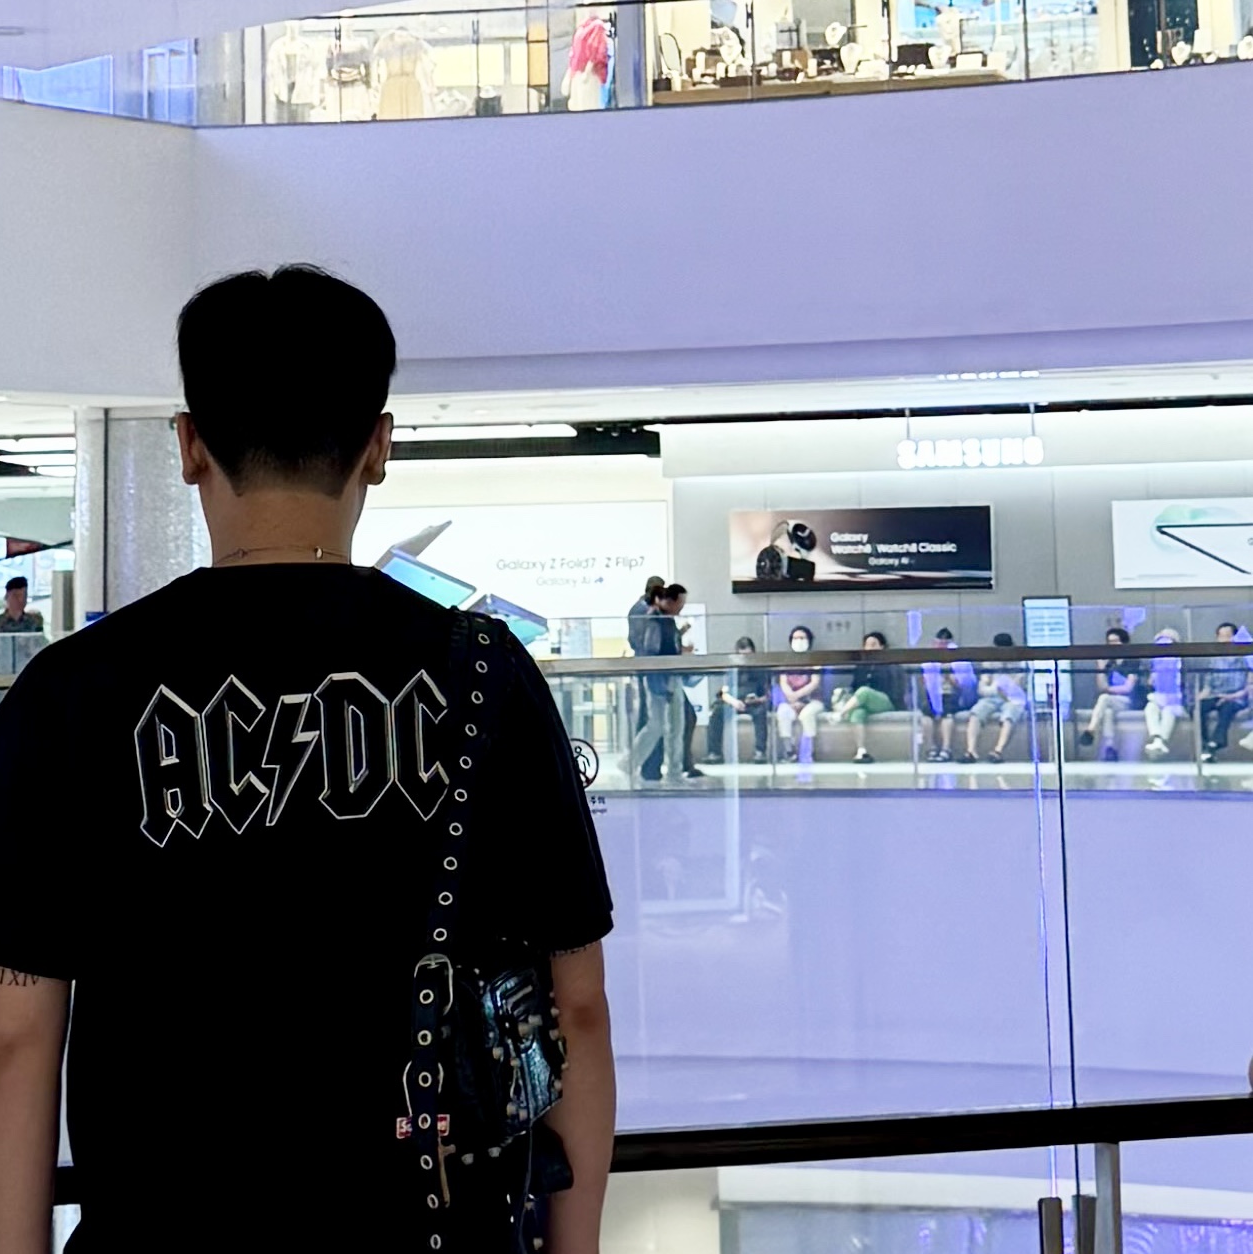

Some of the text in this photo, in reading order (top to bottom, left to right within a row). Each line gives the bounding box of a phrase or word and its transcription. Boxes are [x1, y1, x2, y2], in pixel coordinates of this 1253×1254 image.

[830, 531, 869, 544] Galaxy
[918, 541, 958, 553] Classic
[496, 558, 547, 572] Galaxy
[549, 557, 557, 570] Z
[560, 557, 597, 570] Fold7
[615, 555, 646, 571] Flip7
